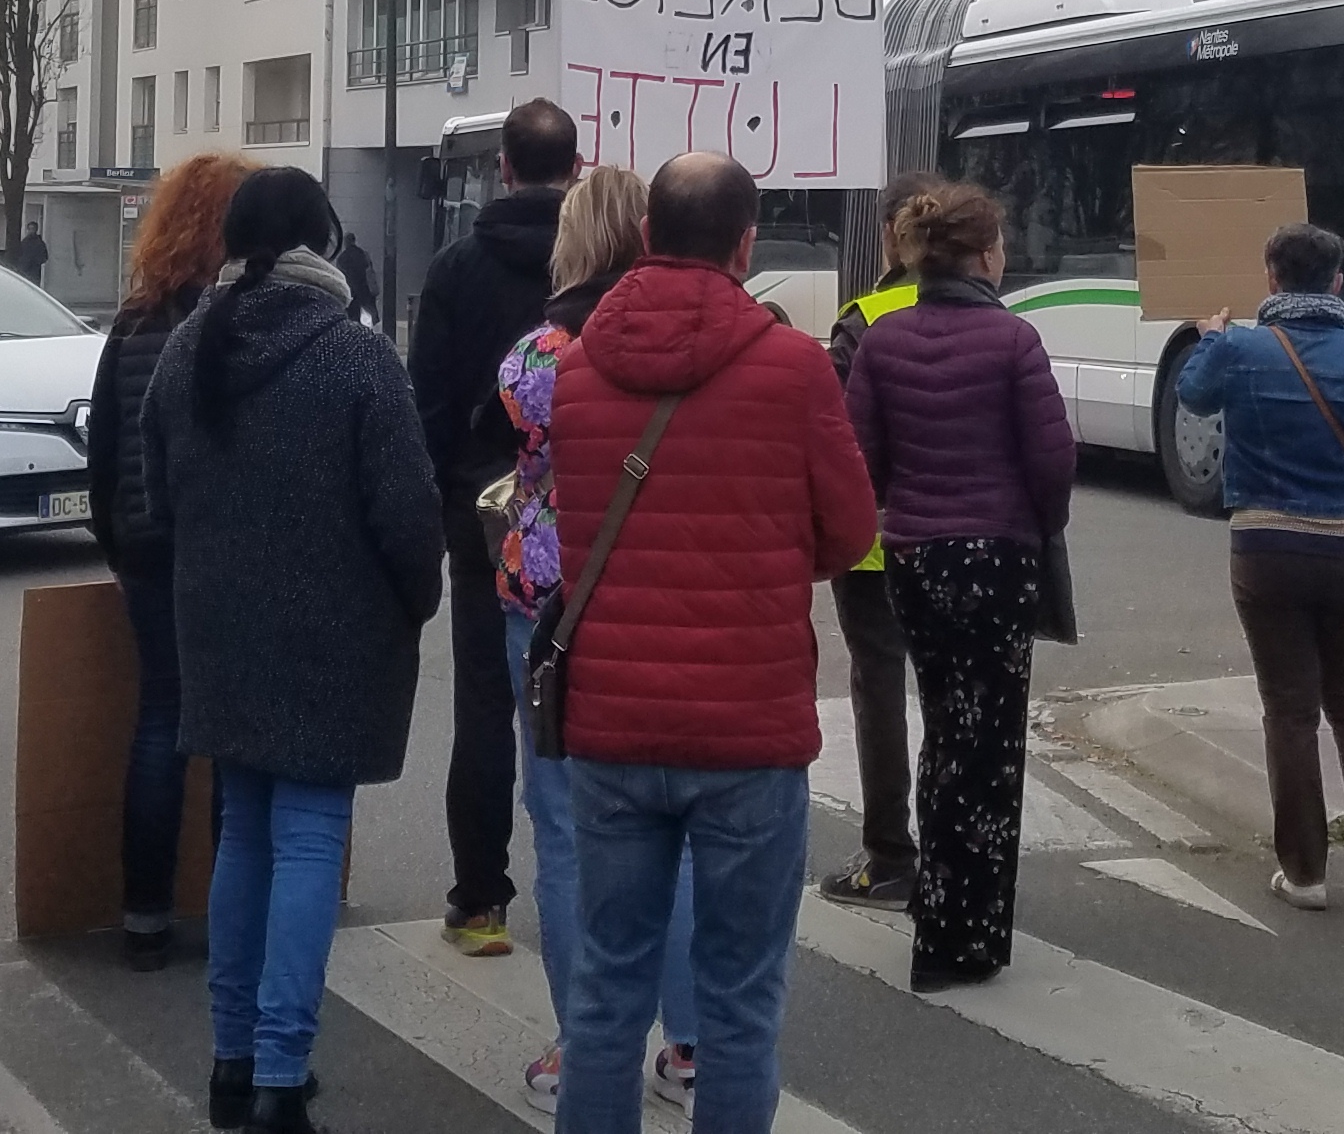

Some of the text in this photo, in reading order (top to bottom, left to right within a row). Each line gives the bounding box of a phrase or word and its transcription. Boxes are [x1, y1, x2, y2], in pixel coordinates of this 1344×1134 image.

[1199, 29, 1229, 45] Nantes
[1196, 40, 1239, 62] Métropole
[52, 495, 88, 517] DC-5
